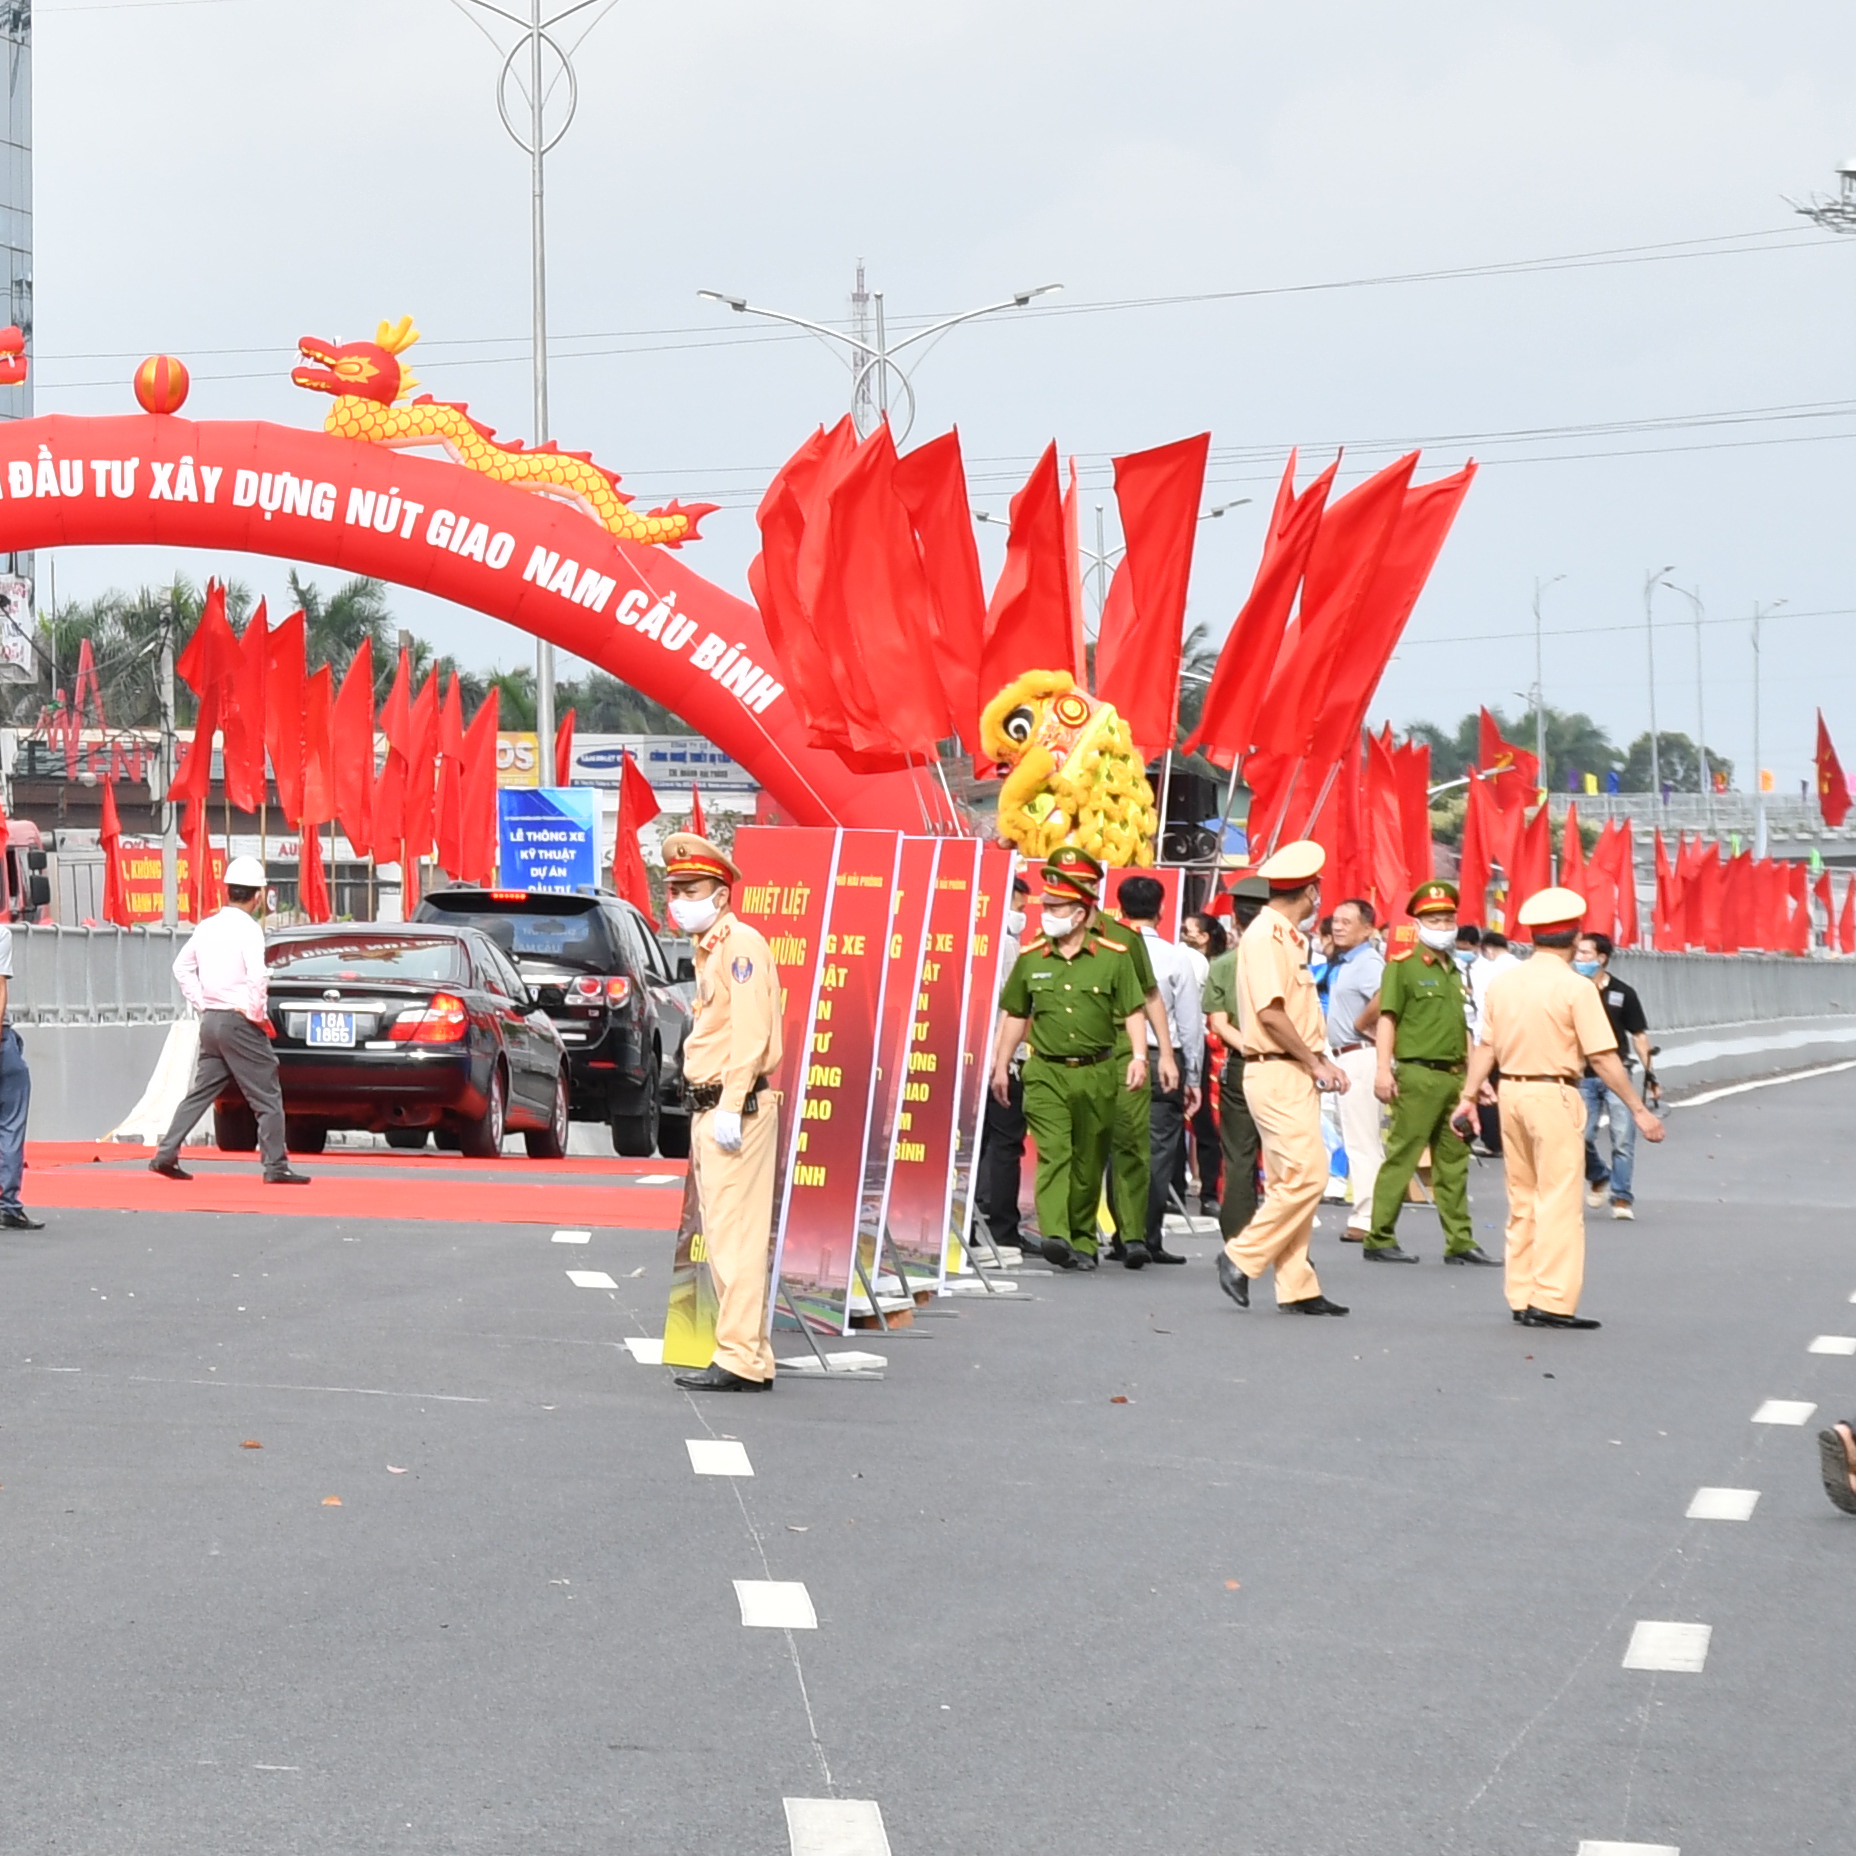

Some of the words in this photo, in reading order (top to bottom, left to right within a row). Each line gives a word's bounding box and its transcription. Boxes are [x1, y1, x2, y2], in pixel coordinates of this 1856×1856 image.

[8, 444, 84, 499] ĐẦU
[90, 457, 139, 499] TƯ
[148, 455, 223, 504] XÂY
[232, 468, 337, 521] DỰNG
[344, 486, 424, 540] NÚT
[426, 508, 516, 570] GIAO
[522, 545, 617, 614] NAM
[615, 590, 699, 651] CẦU
[689, 632, 785, 715] BÍNH
[527, 827, 567, 842] THÔNG
[569, 832, 585, 842] XE
[538, 847, 577, 863] THUẬT
[548, 864, 567, 877] ÁN
[742, 881, 781, 921] NHIỆT
[781, 882, 810, 920] LIỆT
[842, 935, 865, 955] XE
[936, 933, 953, 953] XE
